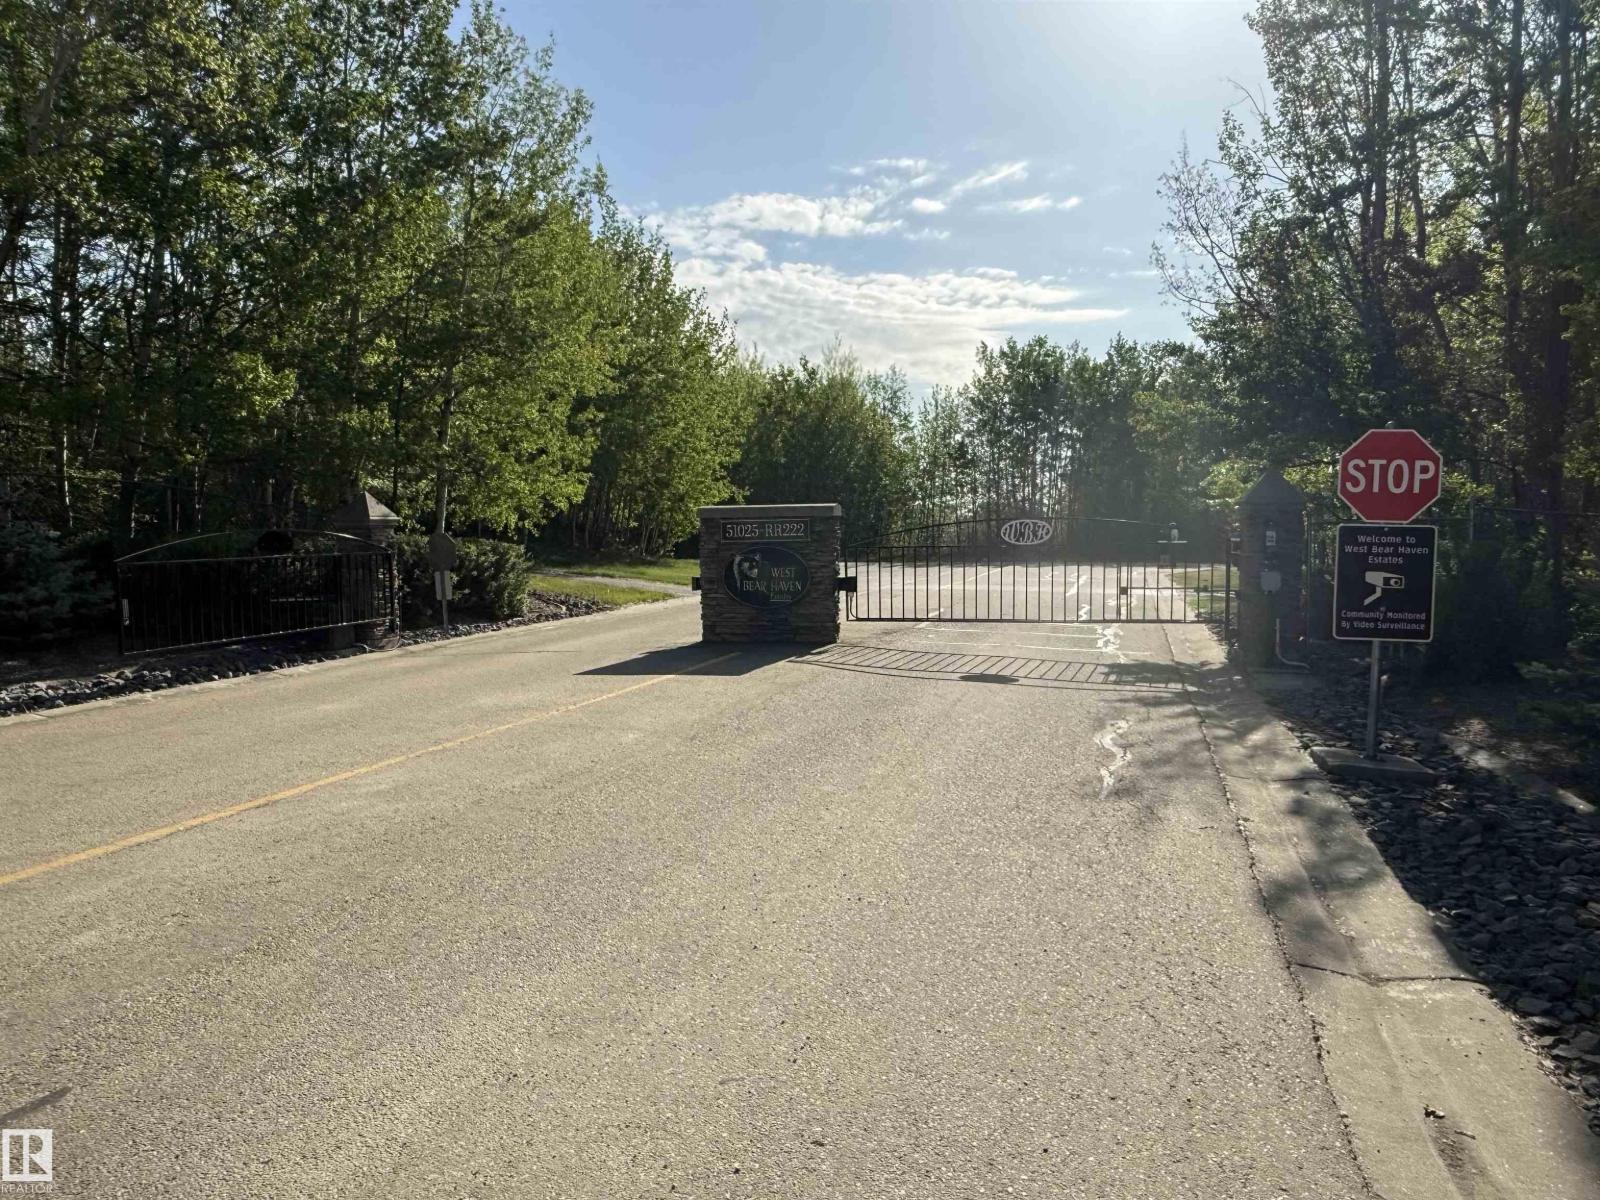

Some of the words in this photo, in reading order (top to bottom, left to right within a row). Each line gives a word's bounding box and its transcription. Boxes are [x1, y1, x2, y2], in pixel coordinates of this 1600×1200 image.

[1345, 459, 1435, 494] STOP
[1357, 535, 1402, 543] Welcome
[1406, 536, 1416, 544] to
[1344, 545, 1368, 553] West
[1371, 545, 1394, 553] Bear
[1398, 545, 1429, 554] Haven
[1368, 555, 1404, 564] Estates
[770, 567, 796, 578] WEST
[743, 581, 767, 592] BEAR
[770, 580, 801, 592] HAVEN
[1341, 610, 1385, 620] Community
[1387, 611, 1426, 620] Monitored
[1341, 620, 1350, 629] By
[1353, 620, 1374, 628] Video
[1377, 621, 1425, 630] Surveillance
